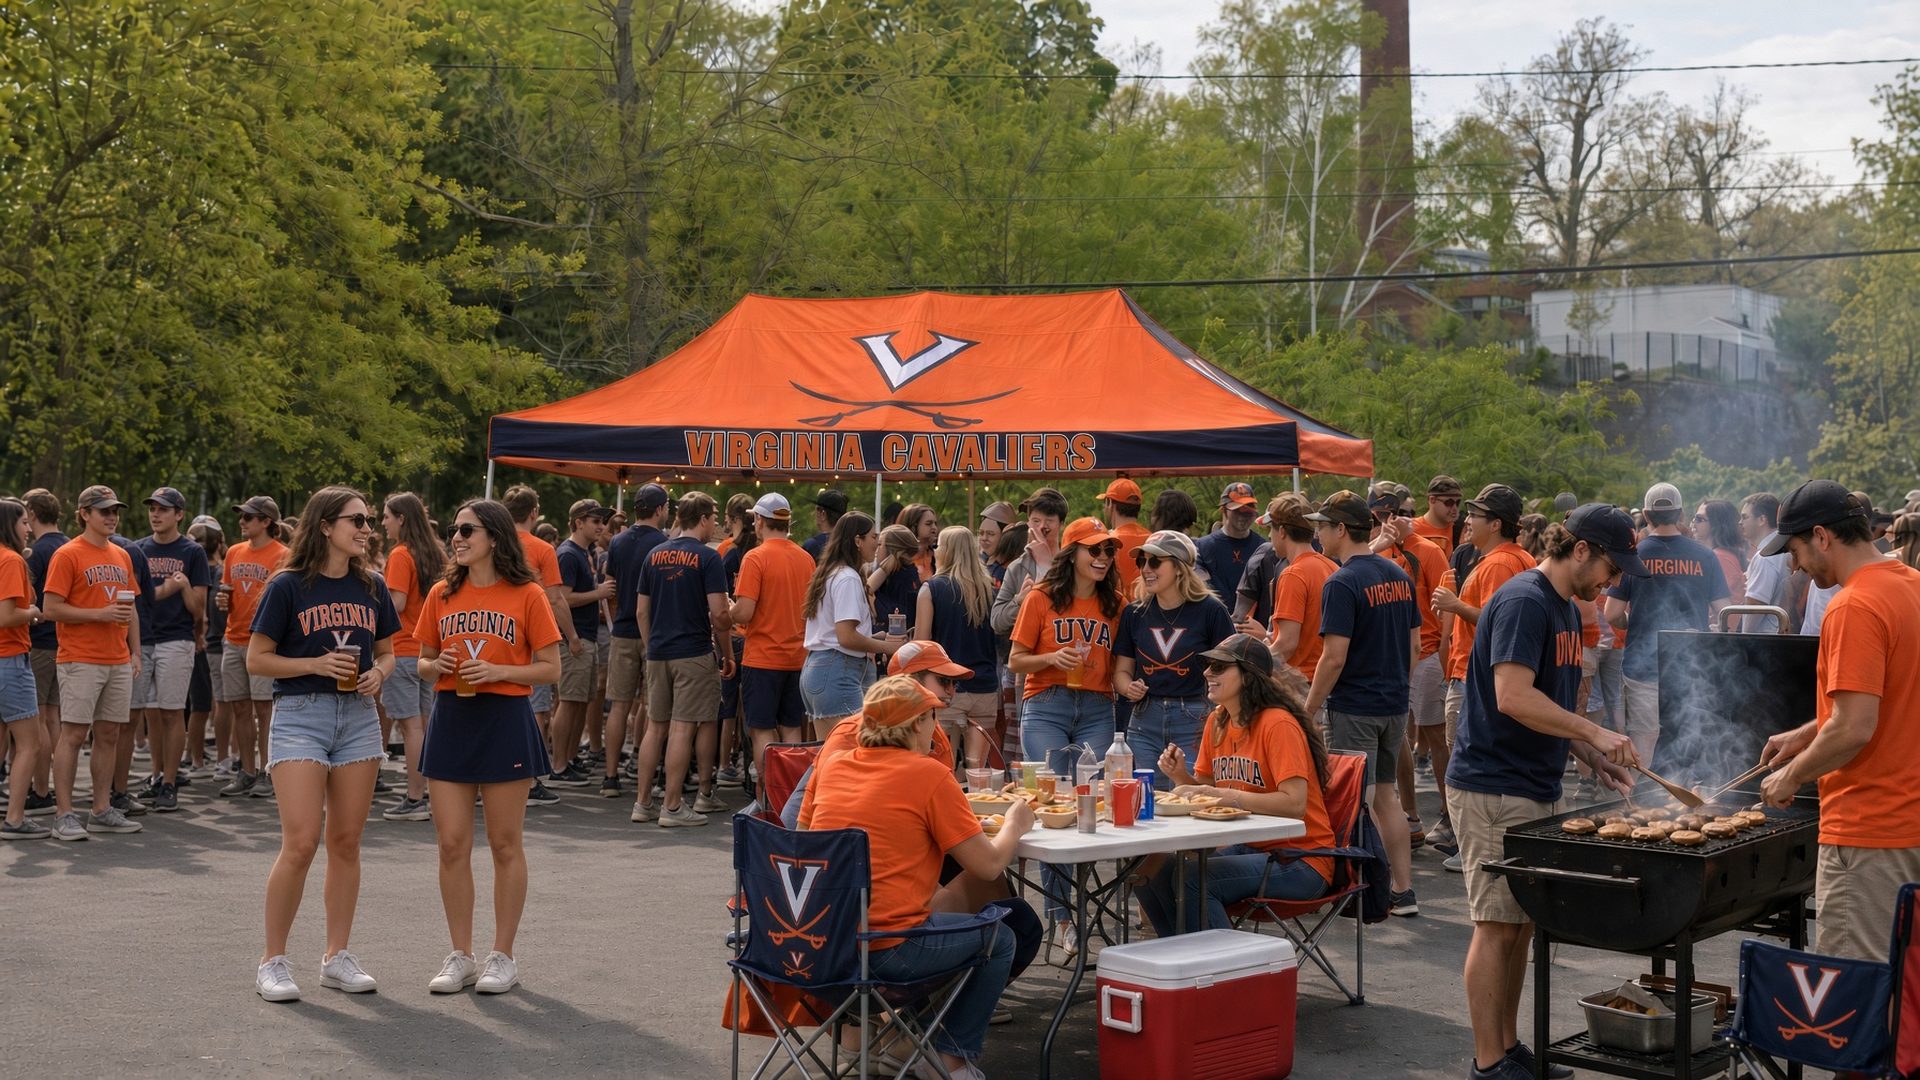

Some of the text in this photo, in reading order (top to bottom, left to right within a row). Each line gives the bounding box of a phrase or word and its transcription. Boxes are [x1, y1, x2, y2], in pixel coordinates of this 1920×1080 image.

[684, 430, 1096, 472] VIRGINIA CAVALIERS
[651, 550, 699, 568] VIRGINIA
[1364, 581, 1412, 608] VIRGINIA
[298, 603, 376, 638] VIRGINIA
[439, 610, 516, 646] VIRGINIA
[1053, 618, 1112, 651] UVA
